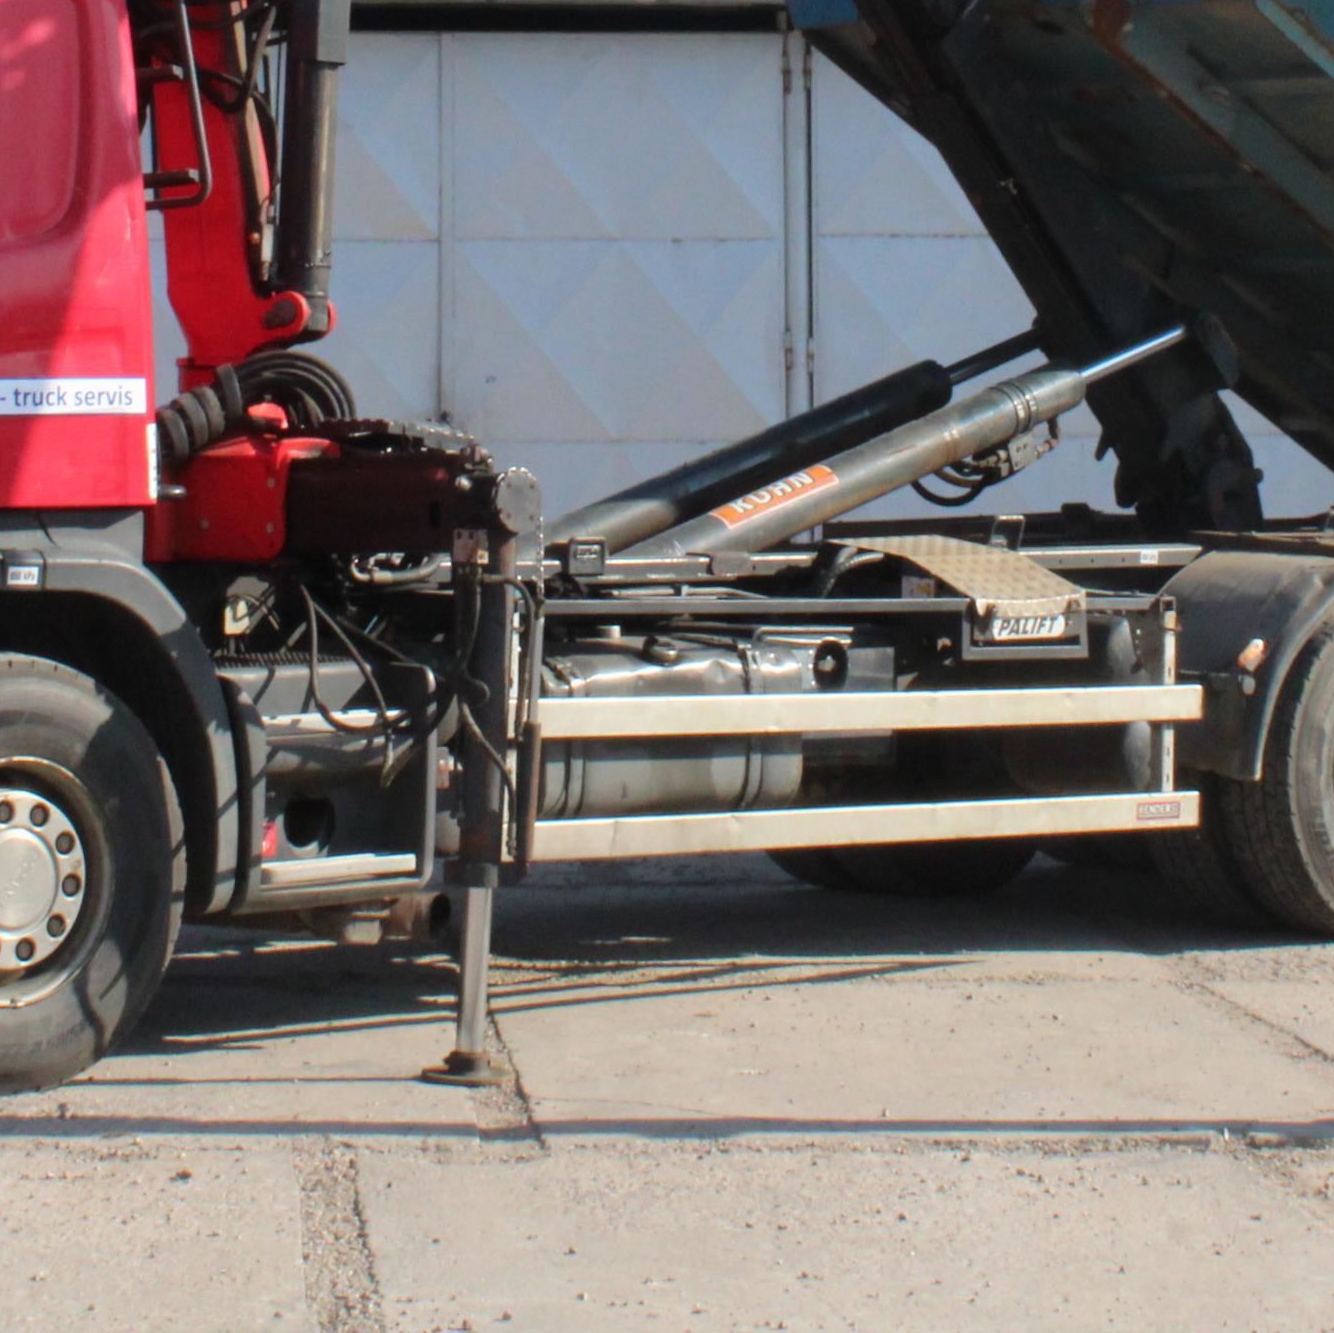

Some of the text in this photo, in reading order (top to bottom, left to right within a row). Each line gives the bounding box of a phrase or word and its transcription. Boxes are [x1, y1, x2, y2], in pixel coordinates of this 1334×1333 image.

[13, 386, 67, 407] truck
[74, 385, 133, 407] servis
[997, 616, 1061, 637] PALIFT
